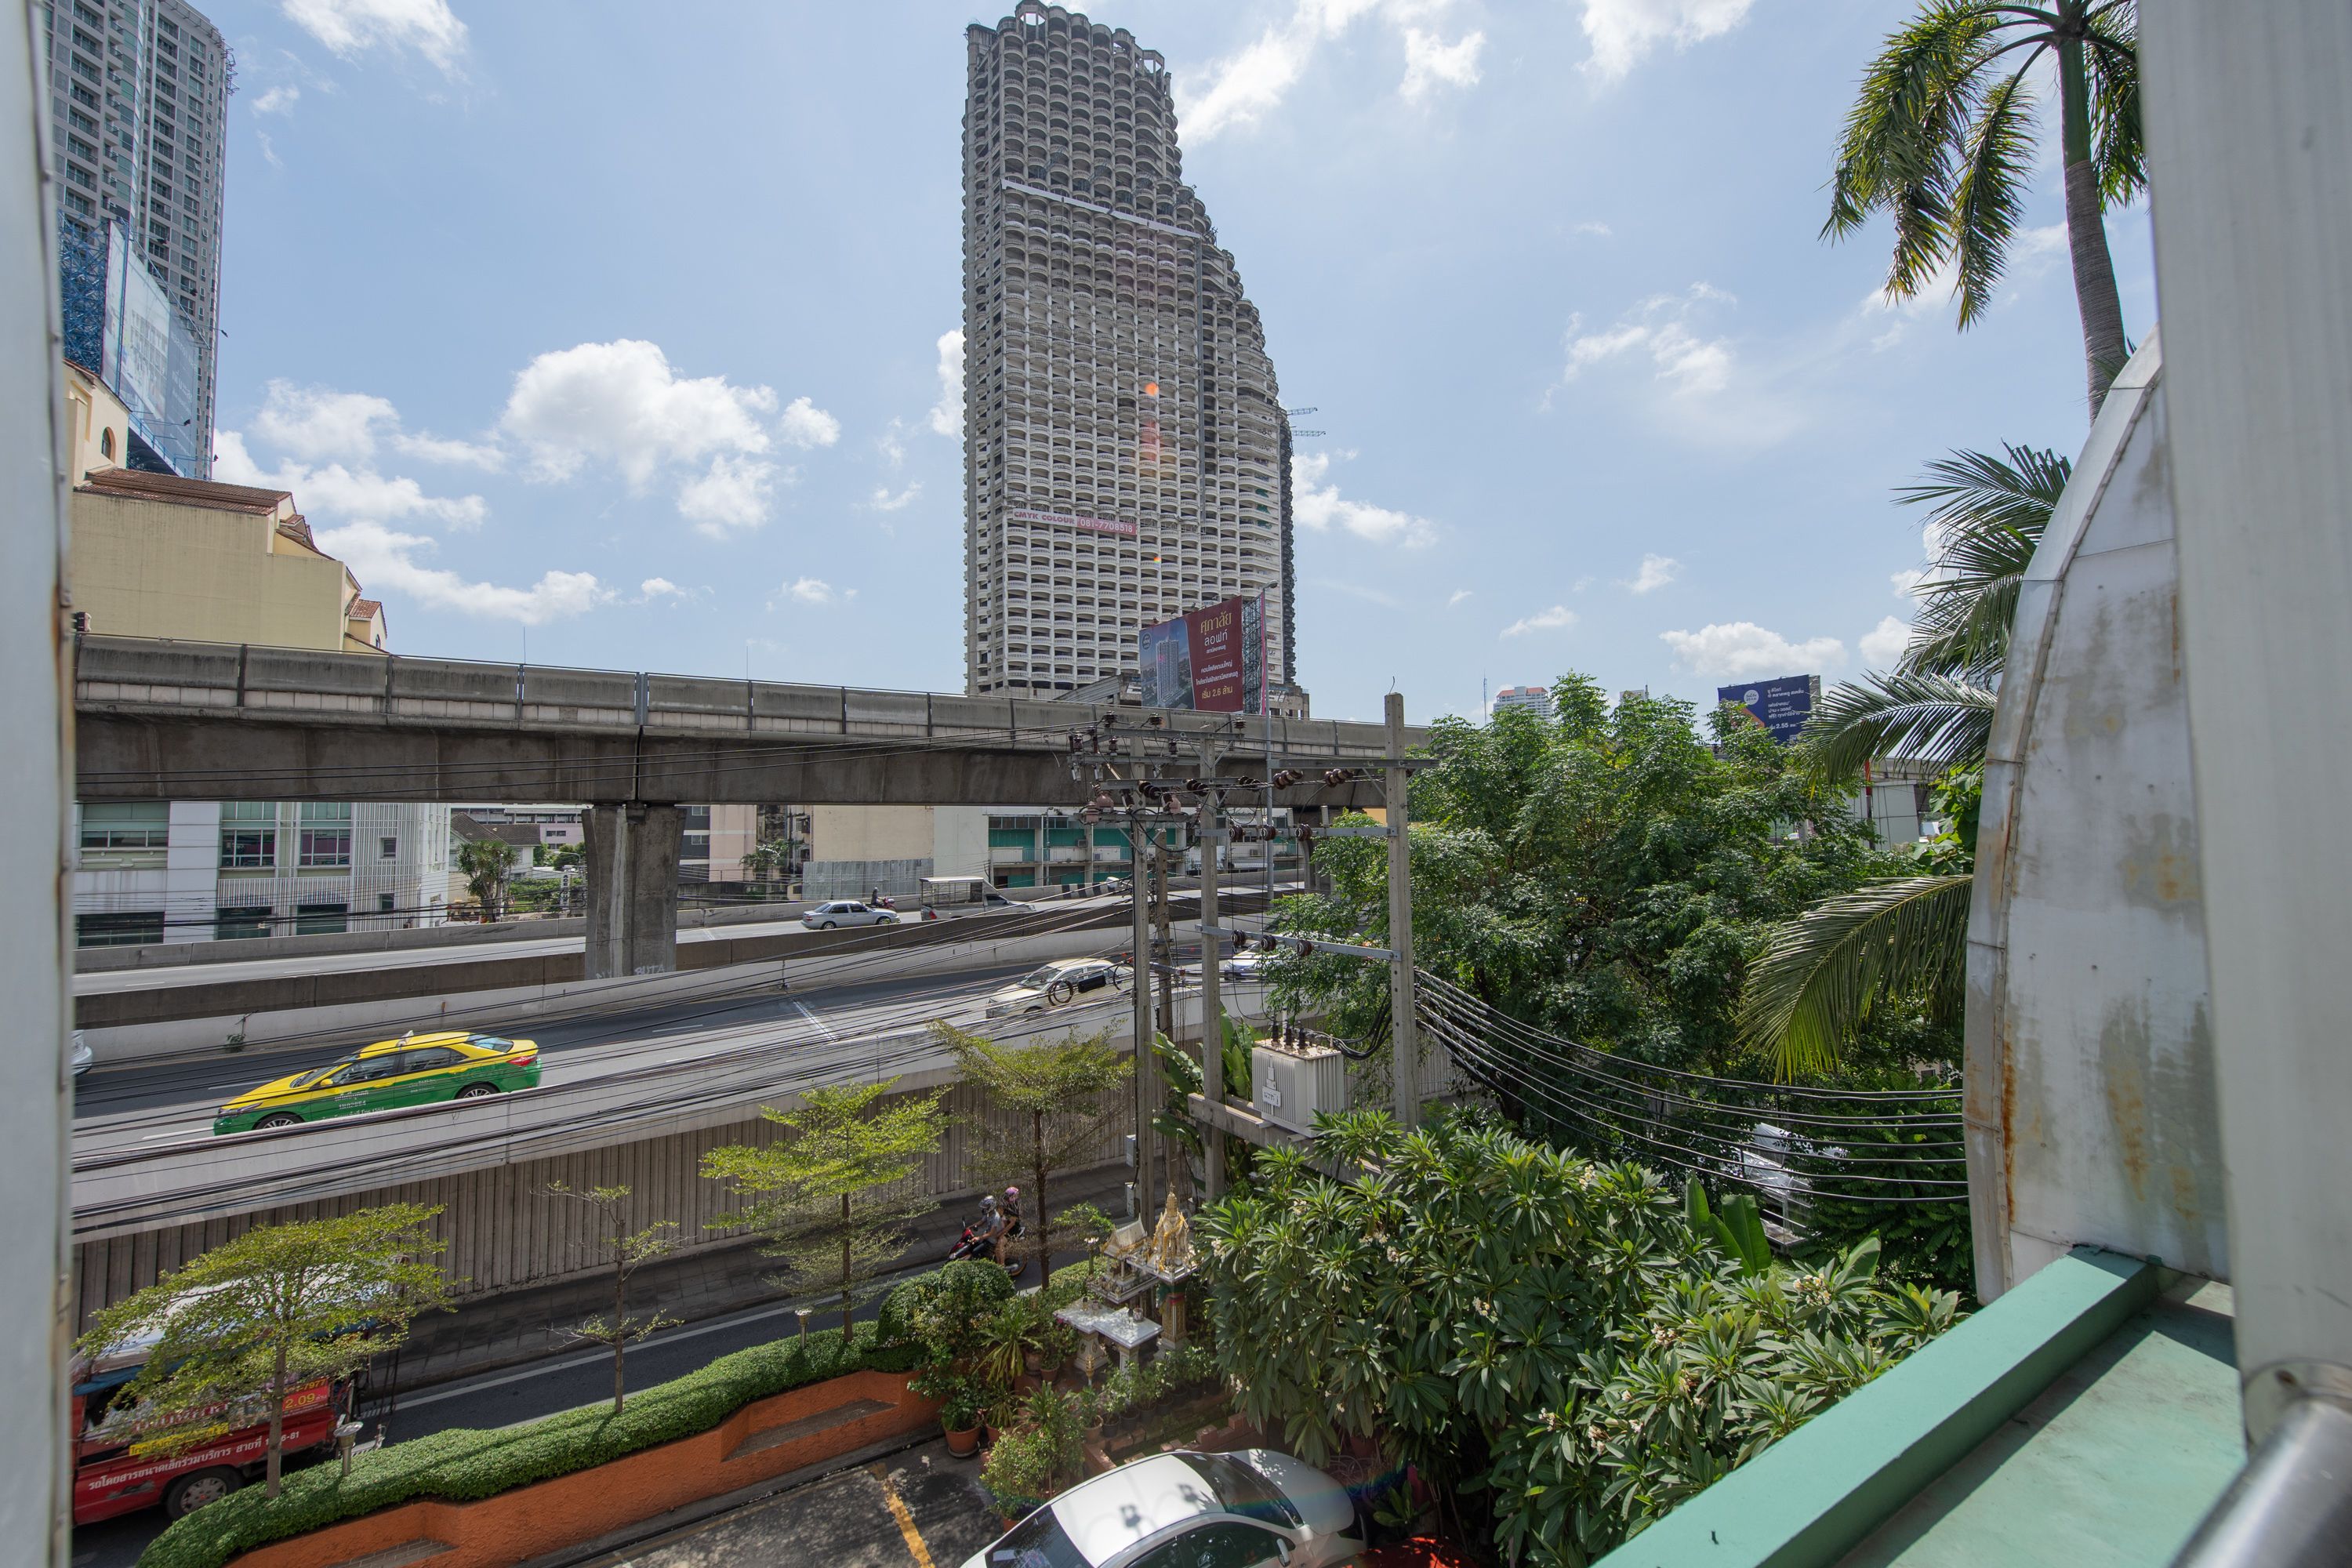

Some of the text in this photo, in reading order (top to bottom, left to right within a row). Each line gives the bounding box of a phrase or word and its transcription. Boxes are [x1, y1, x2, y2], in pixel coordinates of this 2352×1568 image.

[1014, 510, 1074, 524] CMYK COLOUR
[1080, 518, 1133, 533] 081-7708518
[1204, 628, 1228, 646] ลอฟท์
[1201, 685, 1233, 699] เริ่ม 2.6 ล้าน
[285, 1392, 315, 1410] 2.09
[236, 1435, 263, 1453] สายที่
